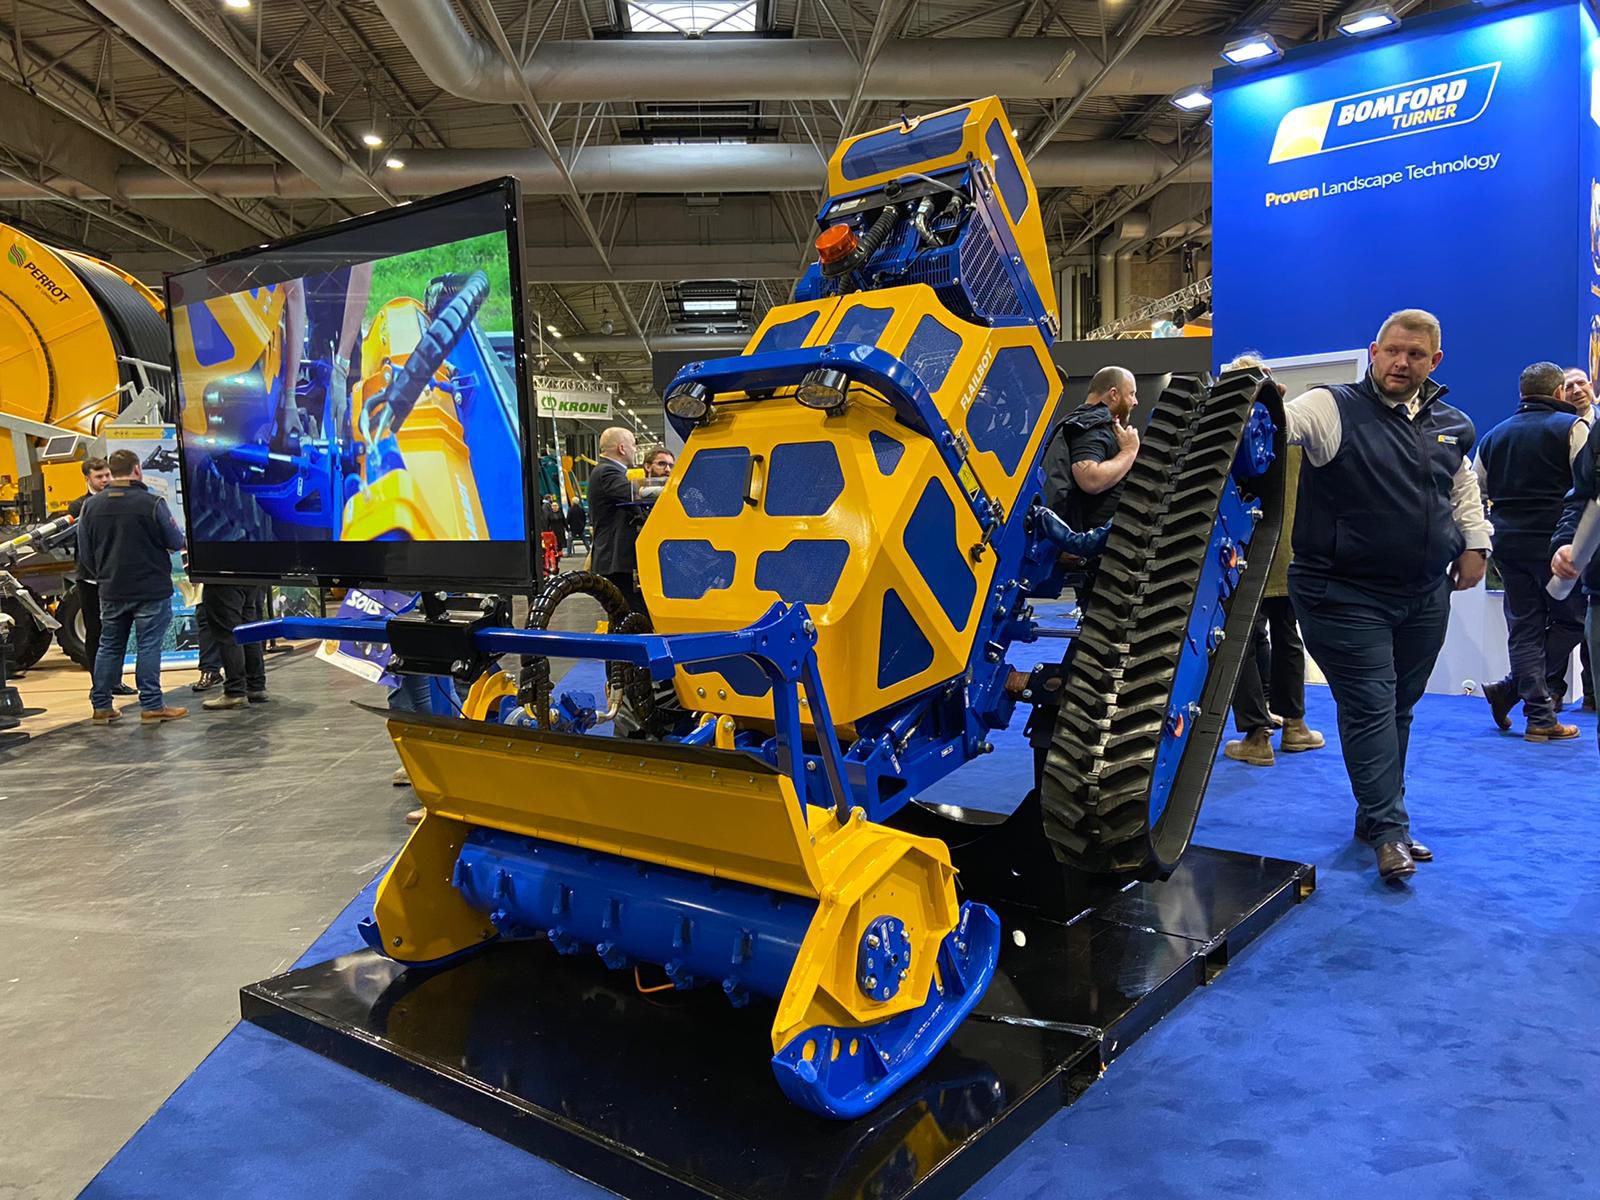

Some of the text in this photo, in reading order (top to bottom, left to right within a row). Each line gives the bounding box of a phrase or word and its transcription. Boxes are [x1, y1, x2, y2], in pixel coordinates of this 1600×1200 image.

[1337, 78, 1468, 127] BOMFORD
[1392, 103, 1458, 130] TURNER
[1265, 152, 1501, 207] Proven Landscape Technology
[24, 262, 71, 302] PERROT
[960, 346, 992, 410] FLAILBOT
[558, 401, 608, 413] KRONE
